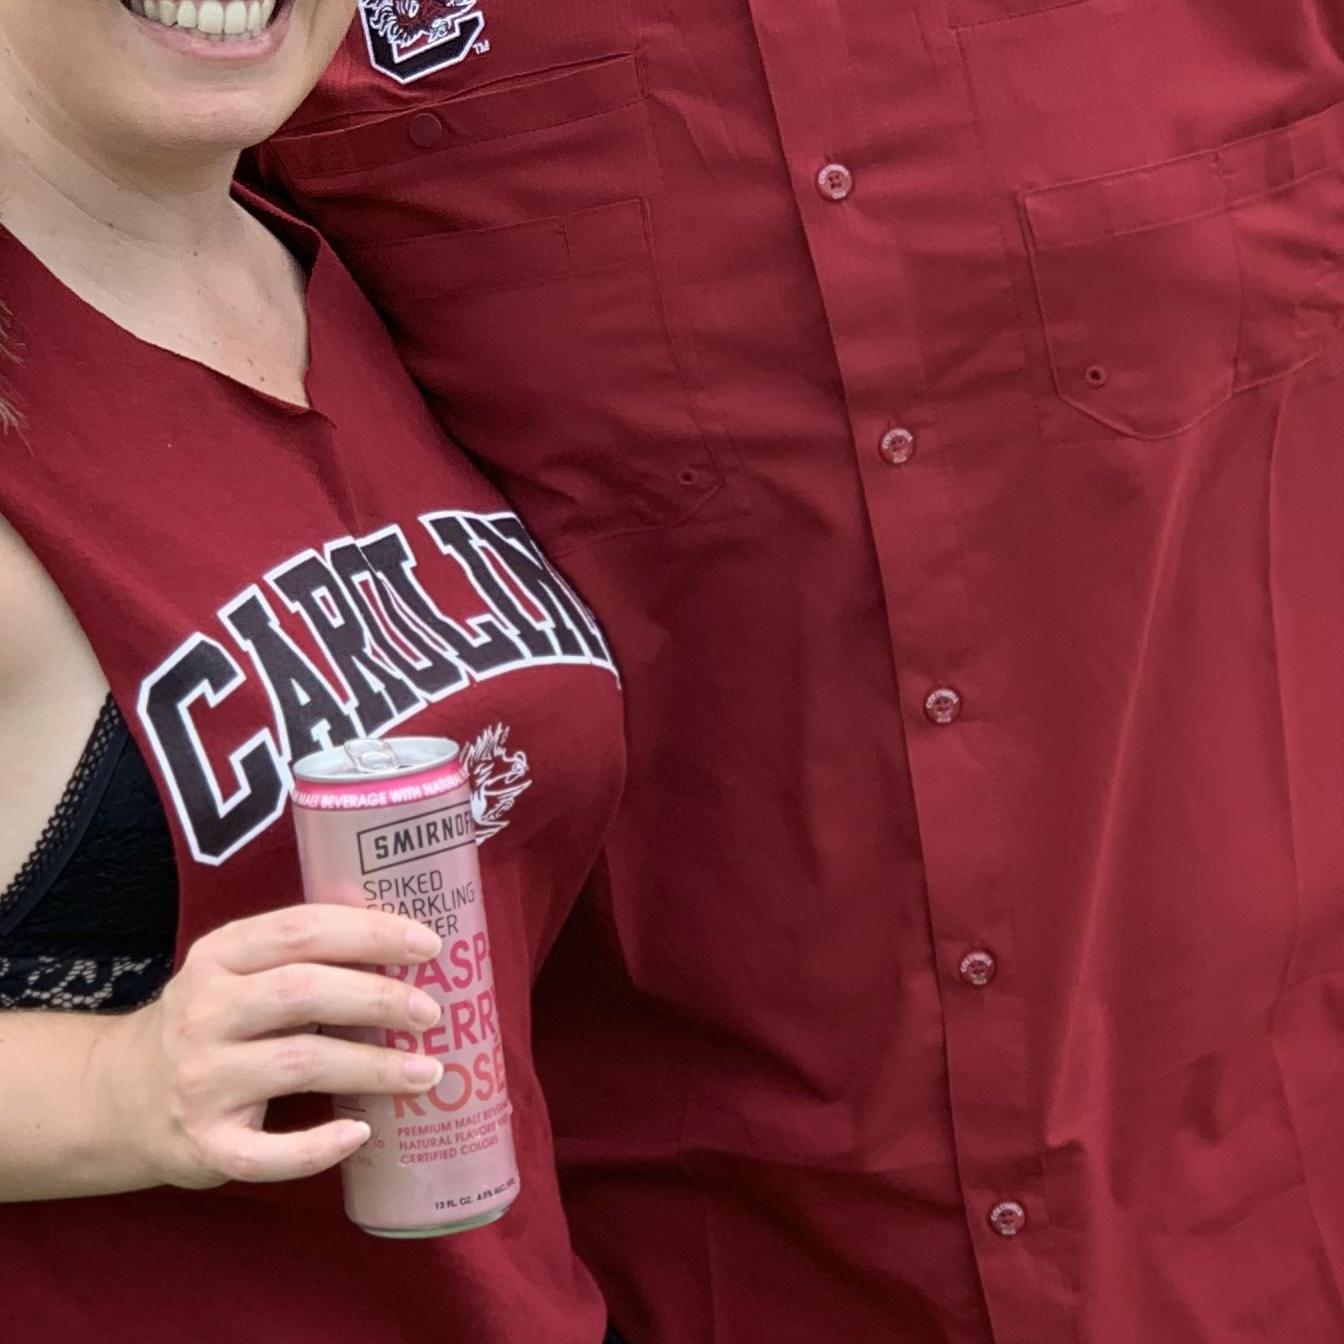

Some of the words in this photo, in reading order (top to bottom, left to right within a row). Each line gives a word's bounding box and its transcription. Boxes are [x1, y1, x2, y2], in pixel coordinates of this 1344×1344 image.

[137, 510, 621, 866] CAROLIN
[321, 792, 387, 809] BEVERAGE
[390, 787, 421, 803] WITH
[363, 869, 443, 902] SPIKED
[397, 1121, 452, 1138] PREMIUM
[455, 1114, 481, 1130] MALT
[399, 1135, 452, 1152] NATURAL
[400, 1147, 458, 1165] CERTIFIED
[460, 1135, 499, 1156] COLORS
